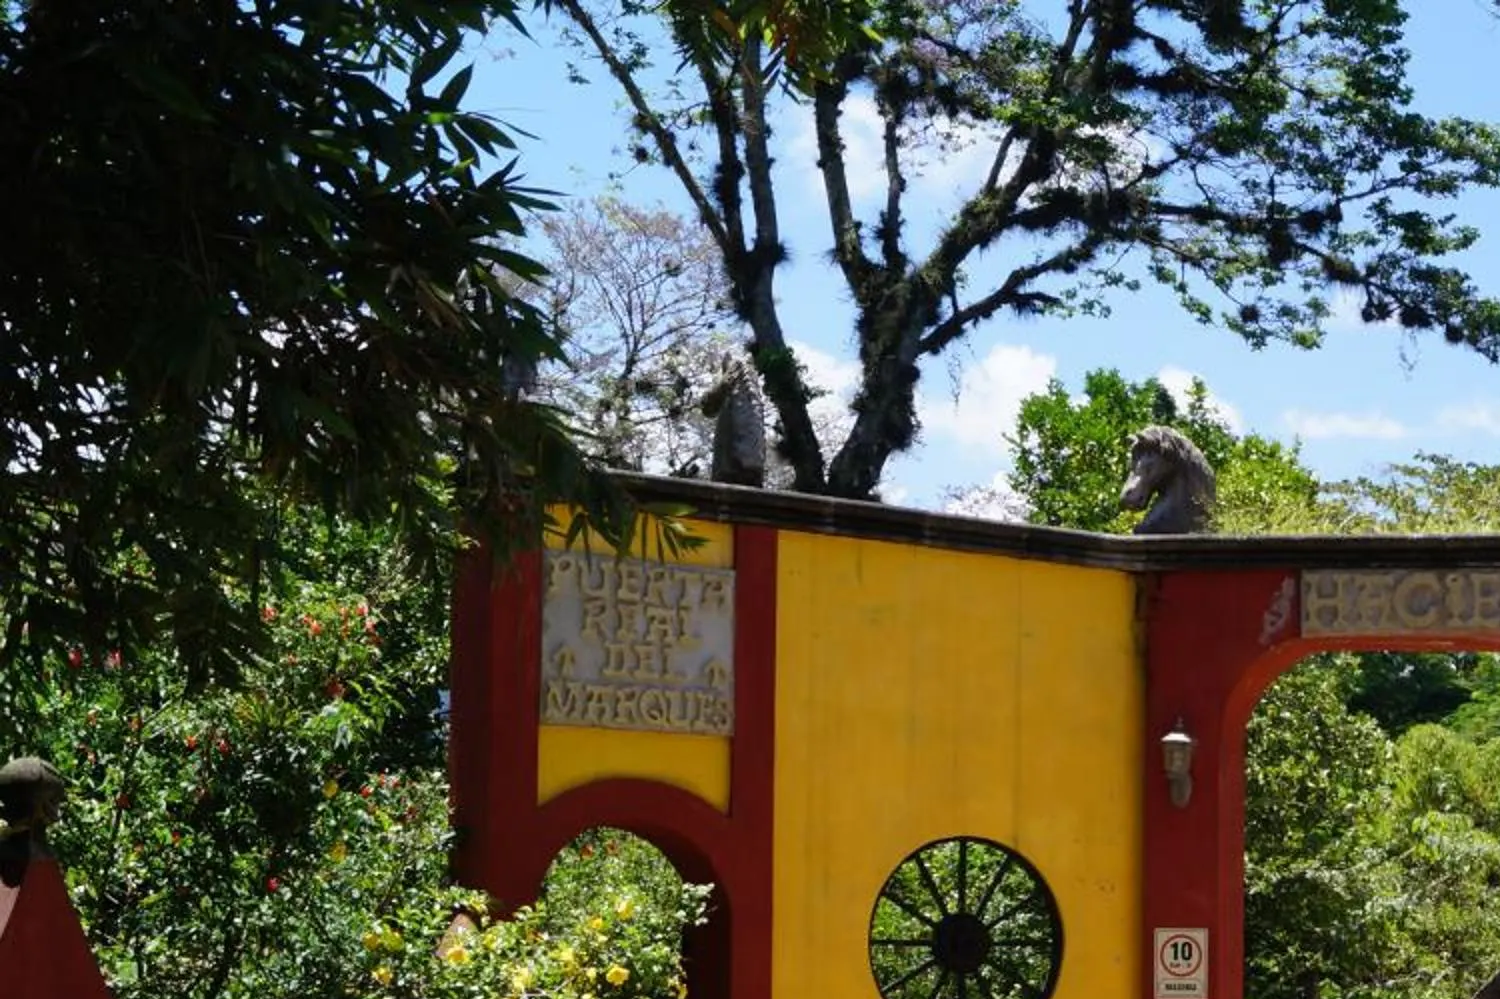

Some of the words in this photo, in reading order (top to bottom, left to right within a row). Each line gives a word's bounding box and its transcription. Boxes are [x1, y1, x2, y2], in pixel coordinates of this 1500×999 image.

[550, 557, 729, 608] PUERTA
[581, 601, 700, 646] REAL
[603, 642, 690, 682] DEL
[546, 683, 731, 730] MARQUES
[1170, 941, 1193, 961] 10
